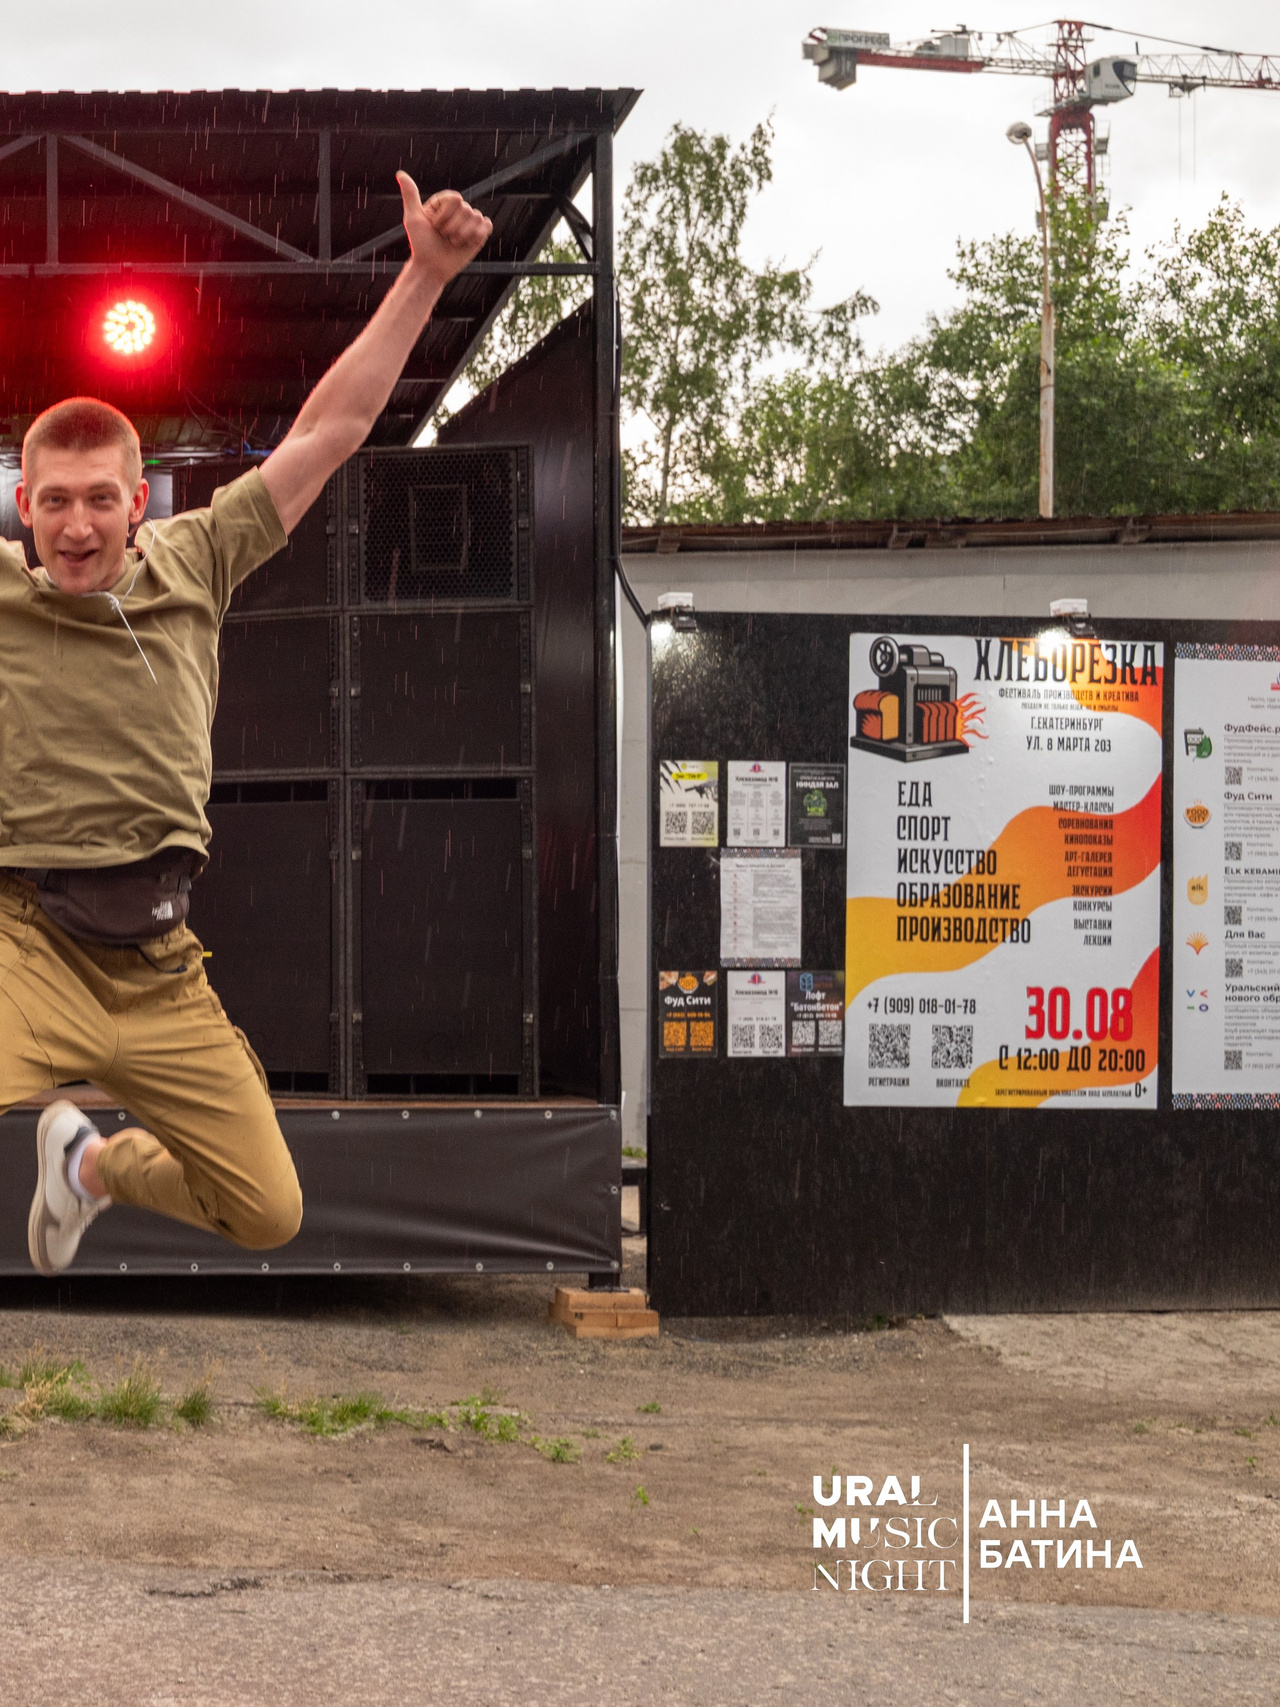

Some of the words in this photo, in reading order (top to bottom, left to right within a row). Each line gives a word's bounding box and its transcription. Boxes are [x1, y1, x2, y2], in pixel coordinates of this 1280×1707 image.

[973, 638, 1158, 686] ХЛЕБОРЕЗКА
[999, 688, 1041, 699] ФЕСТИВАЛЬ
[1044, 689, 1093, 700] ПРОИЗВОДСТВ
[1096, 690, 1101, 700] И
[1103, 691, 1139, 702] КРЕАТИВА
[1030, 717, 1104, 731] Г.ЕКАТЕРИНБУРГ
[1026, 736, 1043, 751] УЛ.
[1047, 737, 1053, 751] 8
[1057, 737, 1091, 752] МАРТА
[1094, 739, 1111, 752] 203
[897, 781, 933, 807] ЕДА
[1049, 784, 1114, 797] ШОУ-ПРОГРАММЫ
[1224, 792, 1245, 801] Фуд
[1247, 792, 1272, 801] Сити
[1053, 801, 1114, 813] МАСТЕР-КЛАССЫ
[1186, 808, 1209, 816] FOOD
[897, 815, 951, 842] СПОРТ
[1058, 817, 1113, 830] СОРЕВНОВАНИЯ
[1064, 833, 1113, 846] КИНОПОКАЗЫ
[896, 848, 997, 875] ИСКУССТВО
[1064, 851, 1112, 863] АРТ-ГАЛЕРЕЯ
[1067, 865, 1113, 878] ДЕГУСТАЦИЯ
[897, 882, 1021, 911] ОБРАЗОВАНИЕ
[1072, 885, 1113, 896] ЭКСКУРСИИ
[1073, 901, 1112, 912] КОНКУРСЫ
[896, 915, 1032, 944] ПРОИЗВОДСТВО
[1073, 918, 1112, 931] ВЫСТАВКИ
[1083, 935, 1112, 946] ЛЕКЦИИ
[1225, 930, 1245, 940] Для
[1248, 930, 1266, 939] Вас
[1225, 983, 1280, 993] Уральский
[665, 995, 685, 1008] Фуд
[686, 995, 711, 1005] Сити
[805, 990, 826, 1002] Лофт
[1263, 993, 1280, 1003] обр
[867, 998, 879, 1013] +7
[884, 996, 914, 1015] (909)
[919, 998, 976, 1014] 018-01-78
[1025, 986, 1133, 1042] 30.08
[999, 1045, 1008, 1070] С
[1017, 1047, 1060, 1071] 12:00
[1066, 1045, 1091, 1072] ДО
[1098, 1049, 1145, 1072] 20:00
[868, 1077, 910, 1087] РЕГИСТРАЦИЯ
[936, 1078, 970, 1088] ВКОНТАКТЕ
